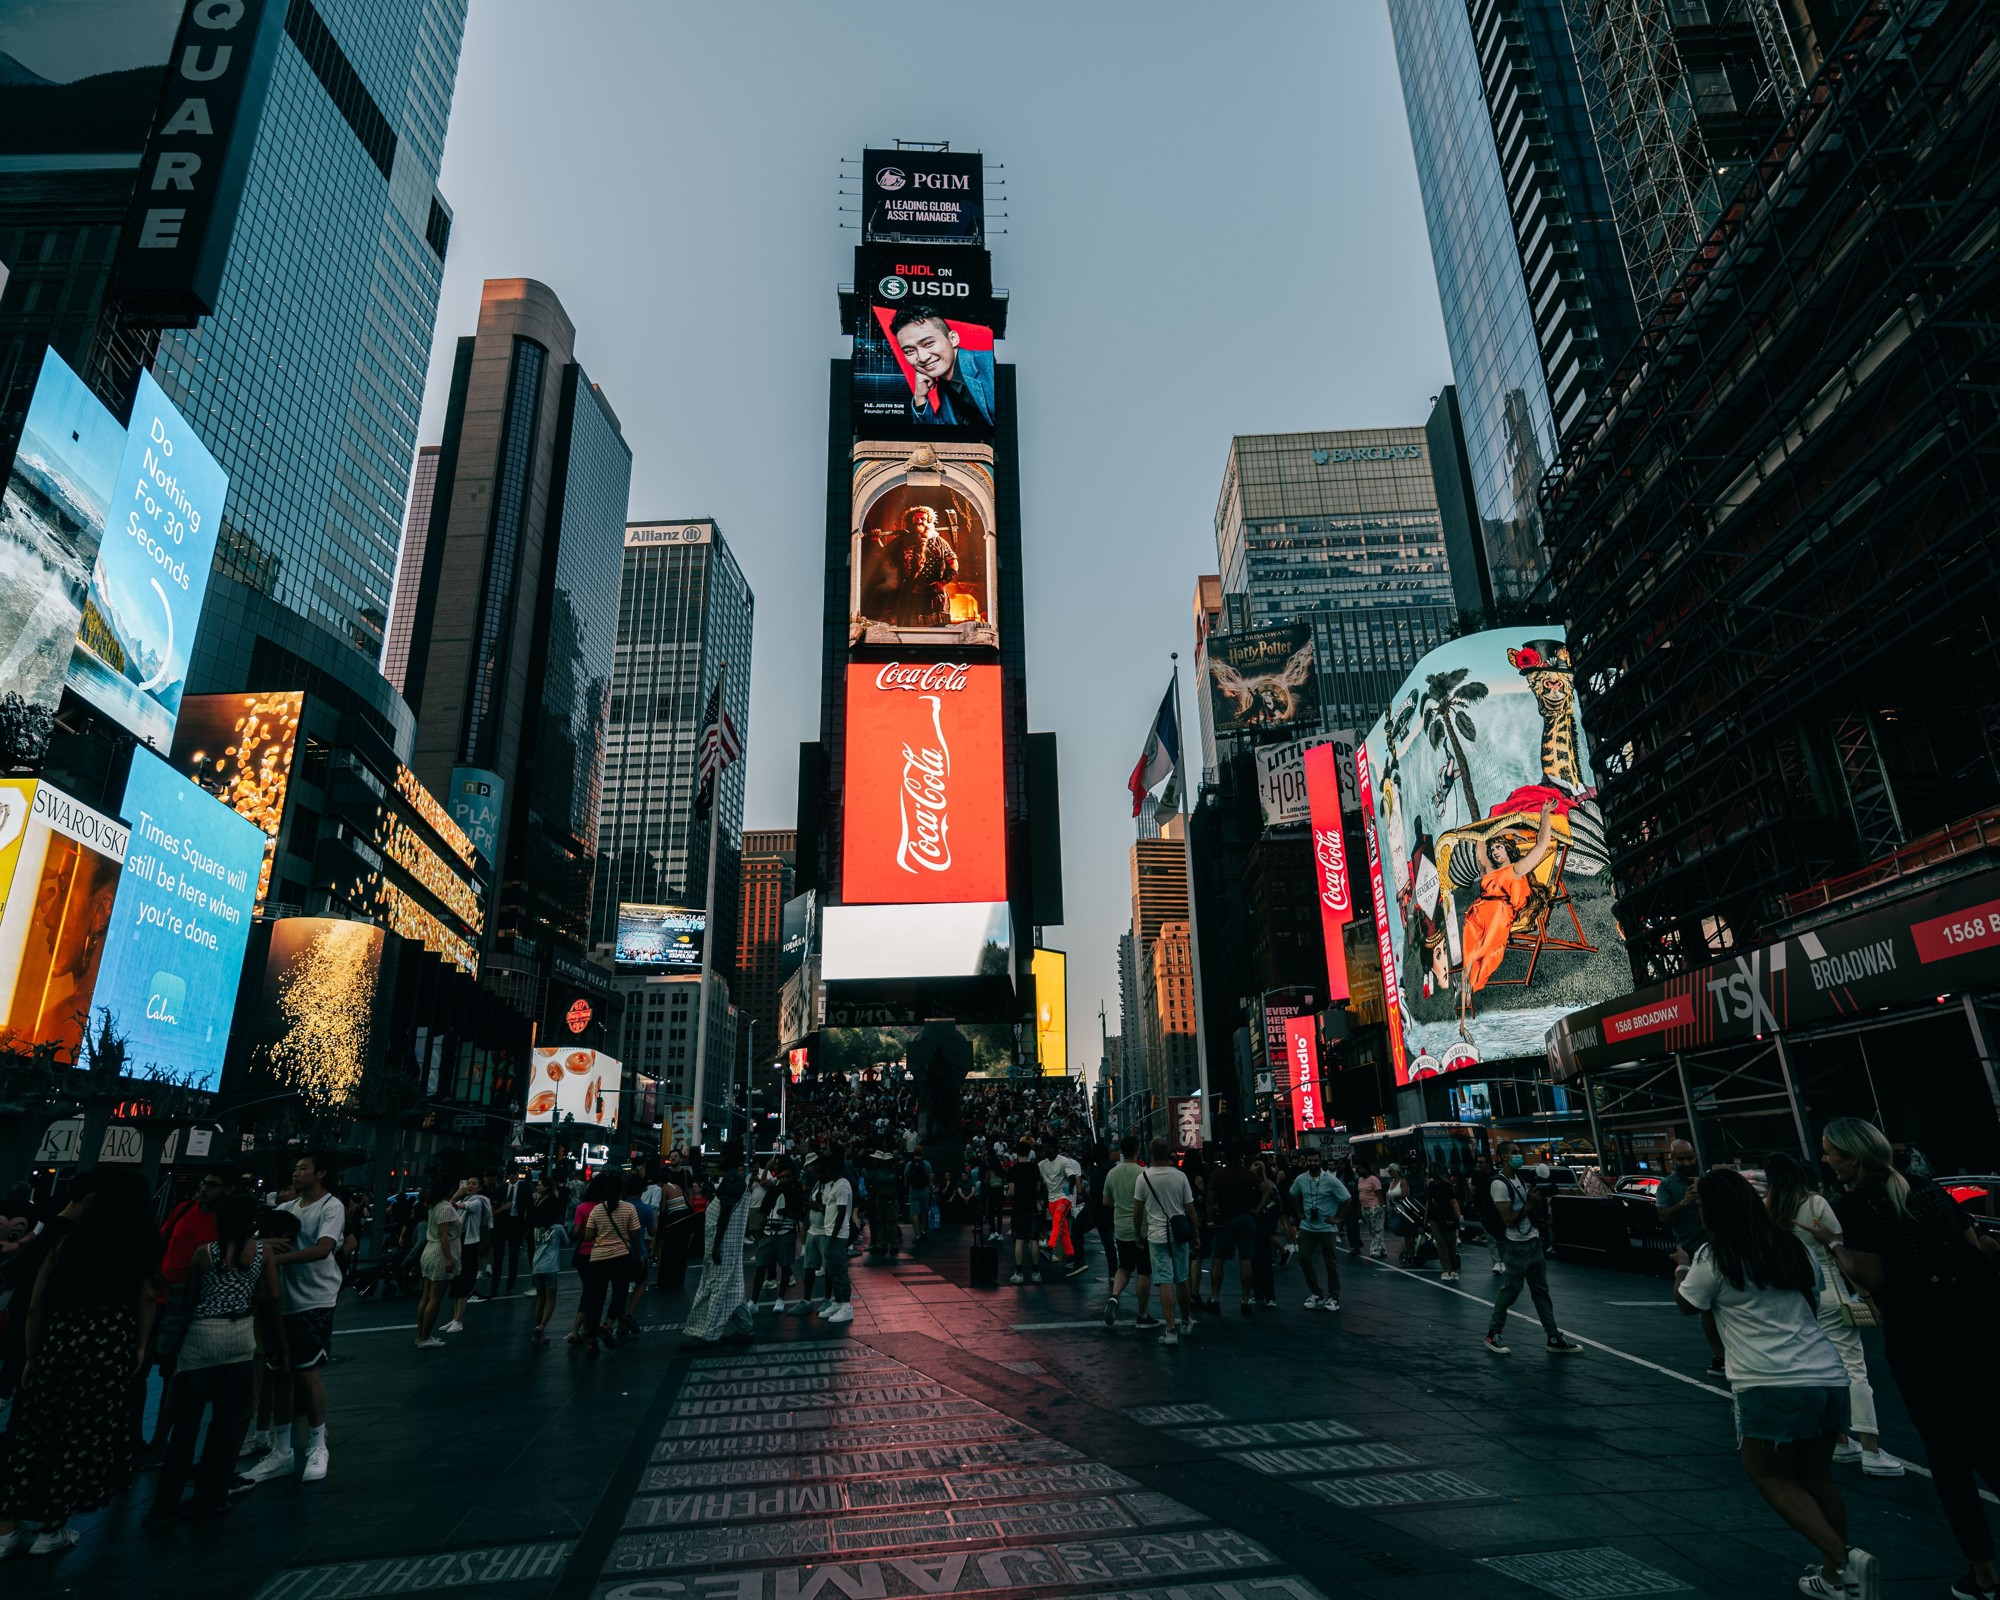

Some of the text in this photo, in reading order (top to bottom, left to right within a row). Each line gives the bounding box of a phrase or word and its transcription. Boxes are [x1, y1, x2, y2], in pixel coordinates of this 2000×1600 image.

[913, 172, 970, 190] PGIM
[885, 200, 961, 212] A LEADING GLOBAL
[887, 210, 959, 223] ASSET MANAGER.
[895, 264, 952, 277] BUIDL ON
[912, 281, 970, 297] USDD
[151, 416, 173, 457] Do
[1332, 445, 1422, 463] BARCLAYS
[143, 448, 203, 534] Nothing
[134, 477, 184, 545] For 30
[630, 529, 679, 543] Allianz
[127, 511, 190, 591] Seconds
[1228, 640, 1292, 664] Harry Potter
[875, 661, 972, 692] Coca-Cola
[33, 788, 129, 858] SWAROVSKI
[897, 742, 951, 875] Coca-Cola
[139, 811, 248, 893] Times Square will
[1316, 828, 1350, 912] Coca-Cola
[128, 853, 240, 925] still be here when
[137, 901, 220, 952] you're done.
[662, 912, 706, 922] SPECTACULAR
[662, 918, 706, 930] AWAITS
[1943, 917, 1986, 944] 1568
[783, 936, 806, 952] FORMULA
[1373, 874, 1398, 1003] COME INSIDE!
[1810, 939, 1897, 992] BROADWAY
[1707, 950, 1779, 1035] TSX
[146, 993, 178, 1026] Calm
[1266, 1006, 1299, 1016] EVERY
[1614, 1005, 1679, 1034] 1568 BROADWAY
[1176, 1101, 1198, 1148] tkts
[757, 1348, 872, 1364] BROADWAY
[686, 1361, 866, 1383] SIMON
[678, 1385, 941, 1416] AMBASSADOR
[684, 1378, 829, 1397] GERSHWIN
[839, 1401, 948, 1423] KERR
[661, 1432, 796, 1453] FRIEDMAN
[1189, 1419, 1364, 1447] PALACE
[649, 1459, 787, 1478] ATKINSON
[799, 1444, 1005, 1477] FONTANNE
[1239, 1442, 1412, 1473] LYCEUM
[646, 1469, 789, 1489] BROOKS
[955, 1482, 1018, 1499] BOX
[1026, 1475, 1127, 1492] MUSIC
[1311, 1470, 1488, 1506] BELASCO
[641, 1484, 840, 1524] IMPERIAL
[954, 1500, 1109, 1523] BOOTH
[1004, 1514, 1122, 1543] SHUBERT
[616, 1538, 824, 1569] MAJESTIC
[1055, 1531, 1245, 1561] HAYES
[250, 1542, 567, 1600] HIRSCHFELD
[1067, 1547, 1269, 1580] HELEN
[1544, 1570, 1680, 1600] STEPHEN
